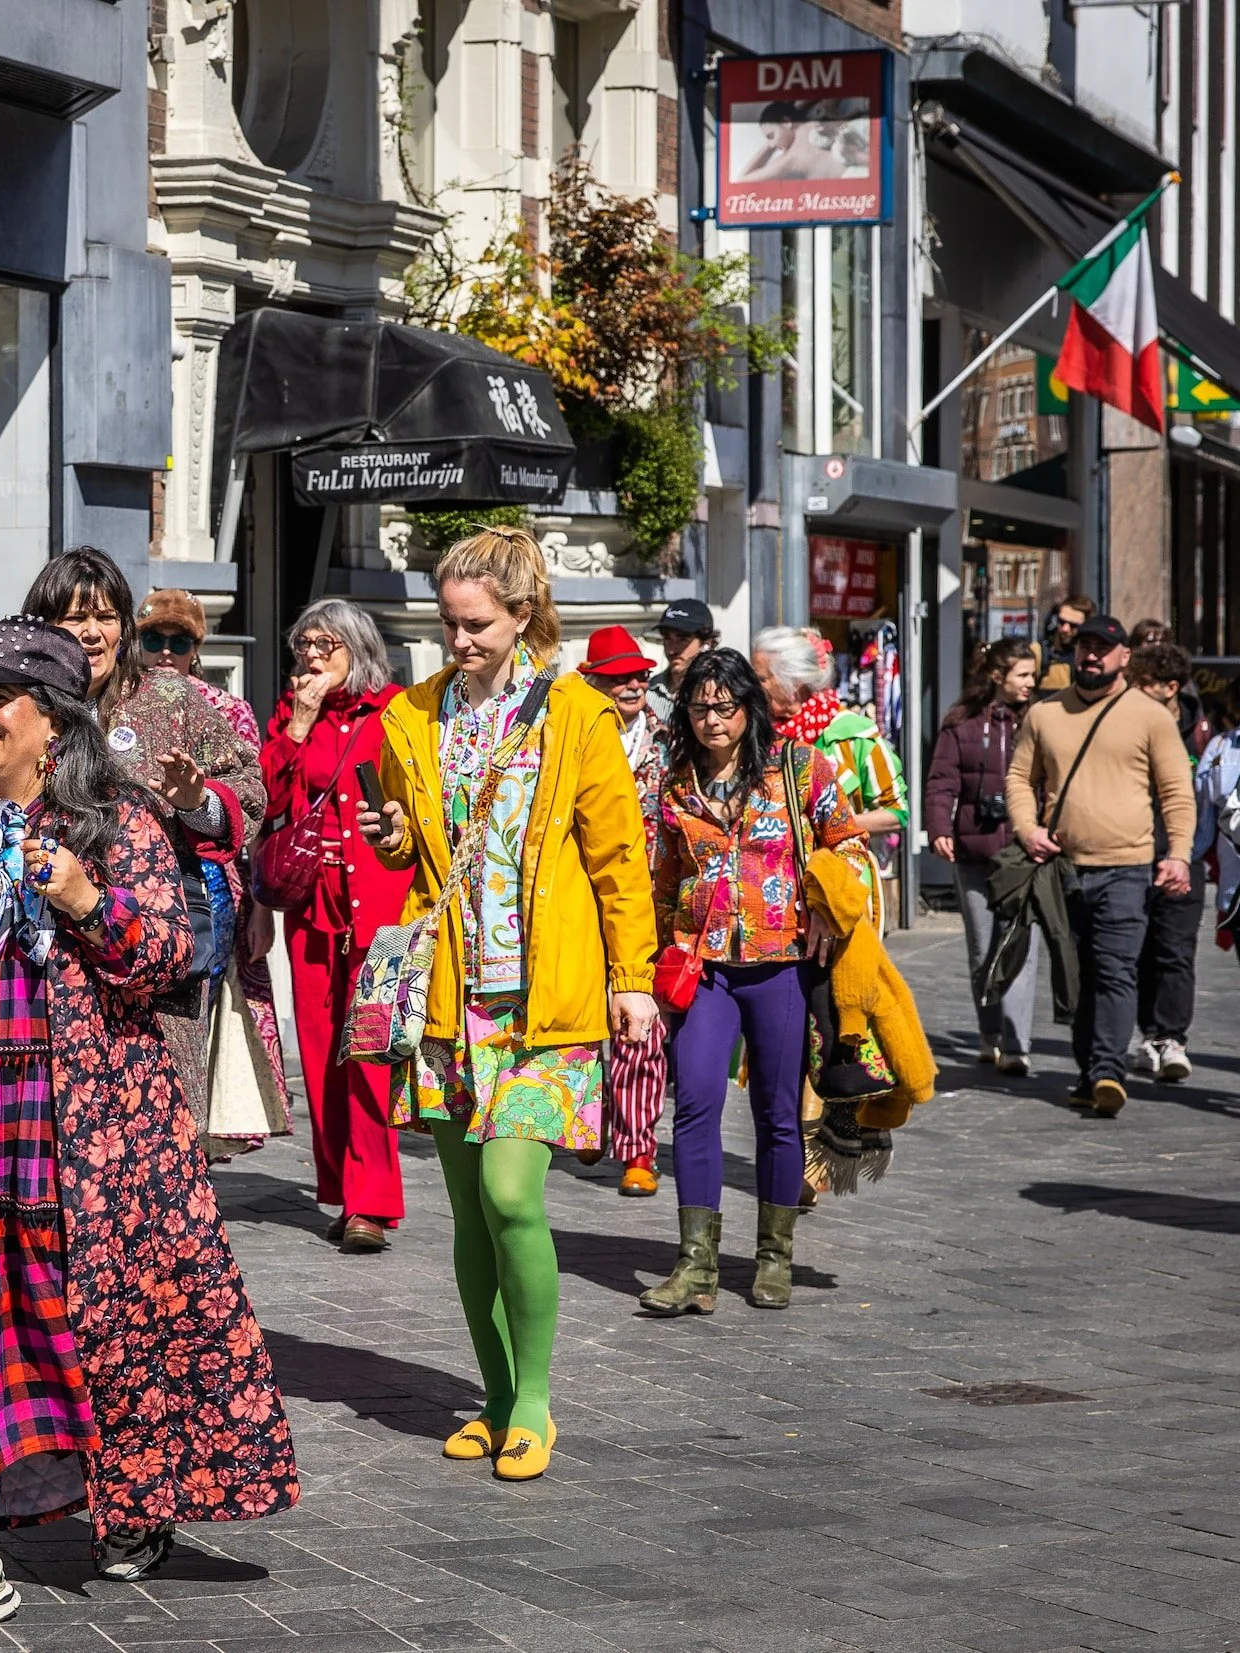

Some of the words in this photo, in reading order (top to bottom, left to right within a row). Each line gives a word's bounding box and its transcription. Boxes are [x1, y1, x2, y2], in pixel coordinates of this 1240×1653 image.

[757, 58, 843, 92] DAM
[725, 192, 794, 214] Tibetan
[797, 191, 877, 215] Massage
[341, 452, 431, 469] RESTAURANT
[306, 469, 355, 491] FuLu
[360, 463, 465, 489] Mandarijn
[500, 464, 518, 485] FuLu
[519, 466, 558, 494] Mandarijn
